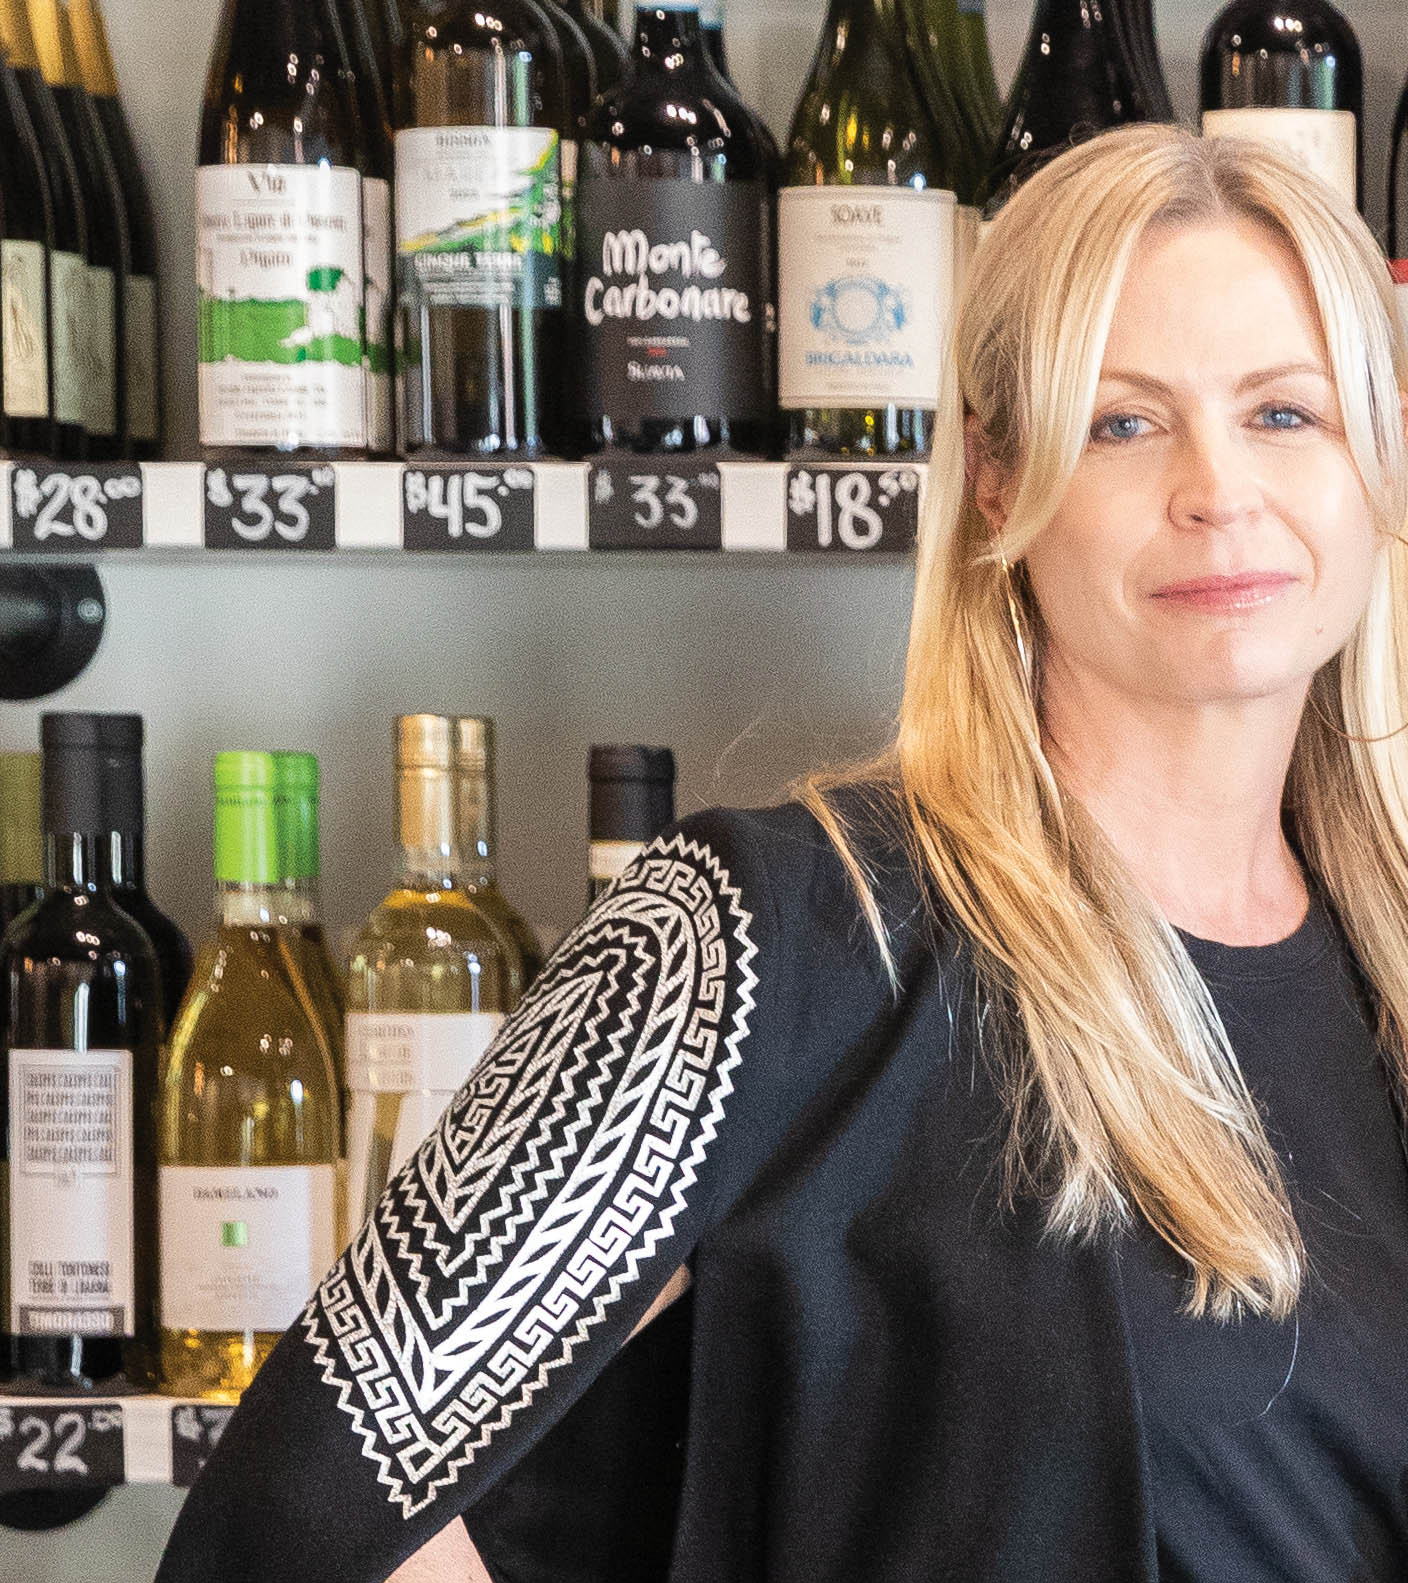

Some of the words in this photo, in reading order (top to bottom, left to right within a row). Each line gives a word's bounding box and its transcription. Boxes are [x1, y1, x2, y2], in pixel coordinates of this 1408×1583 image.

[603, 229, 726, 278] Monte
[585, 274, 751, 325] Carbonare
[789, 470, 919, 550] $18.50
